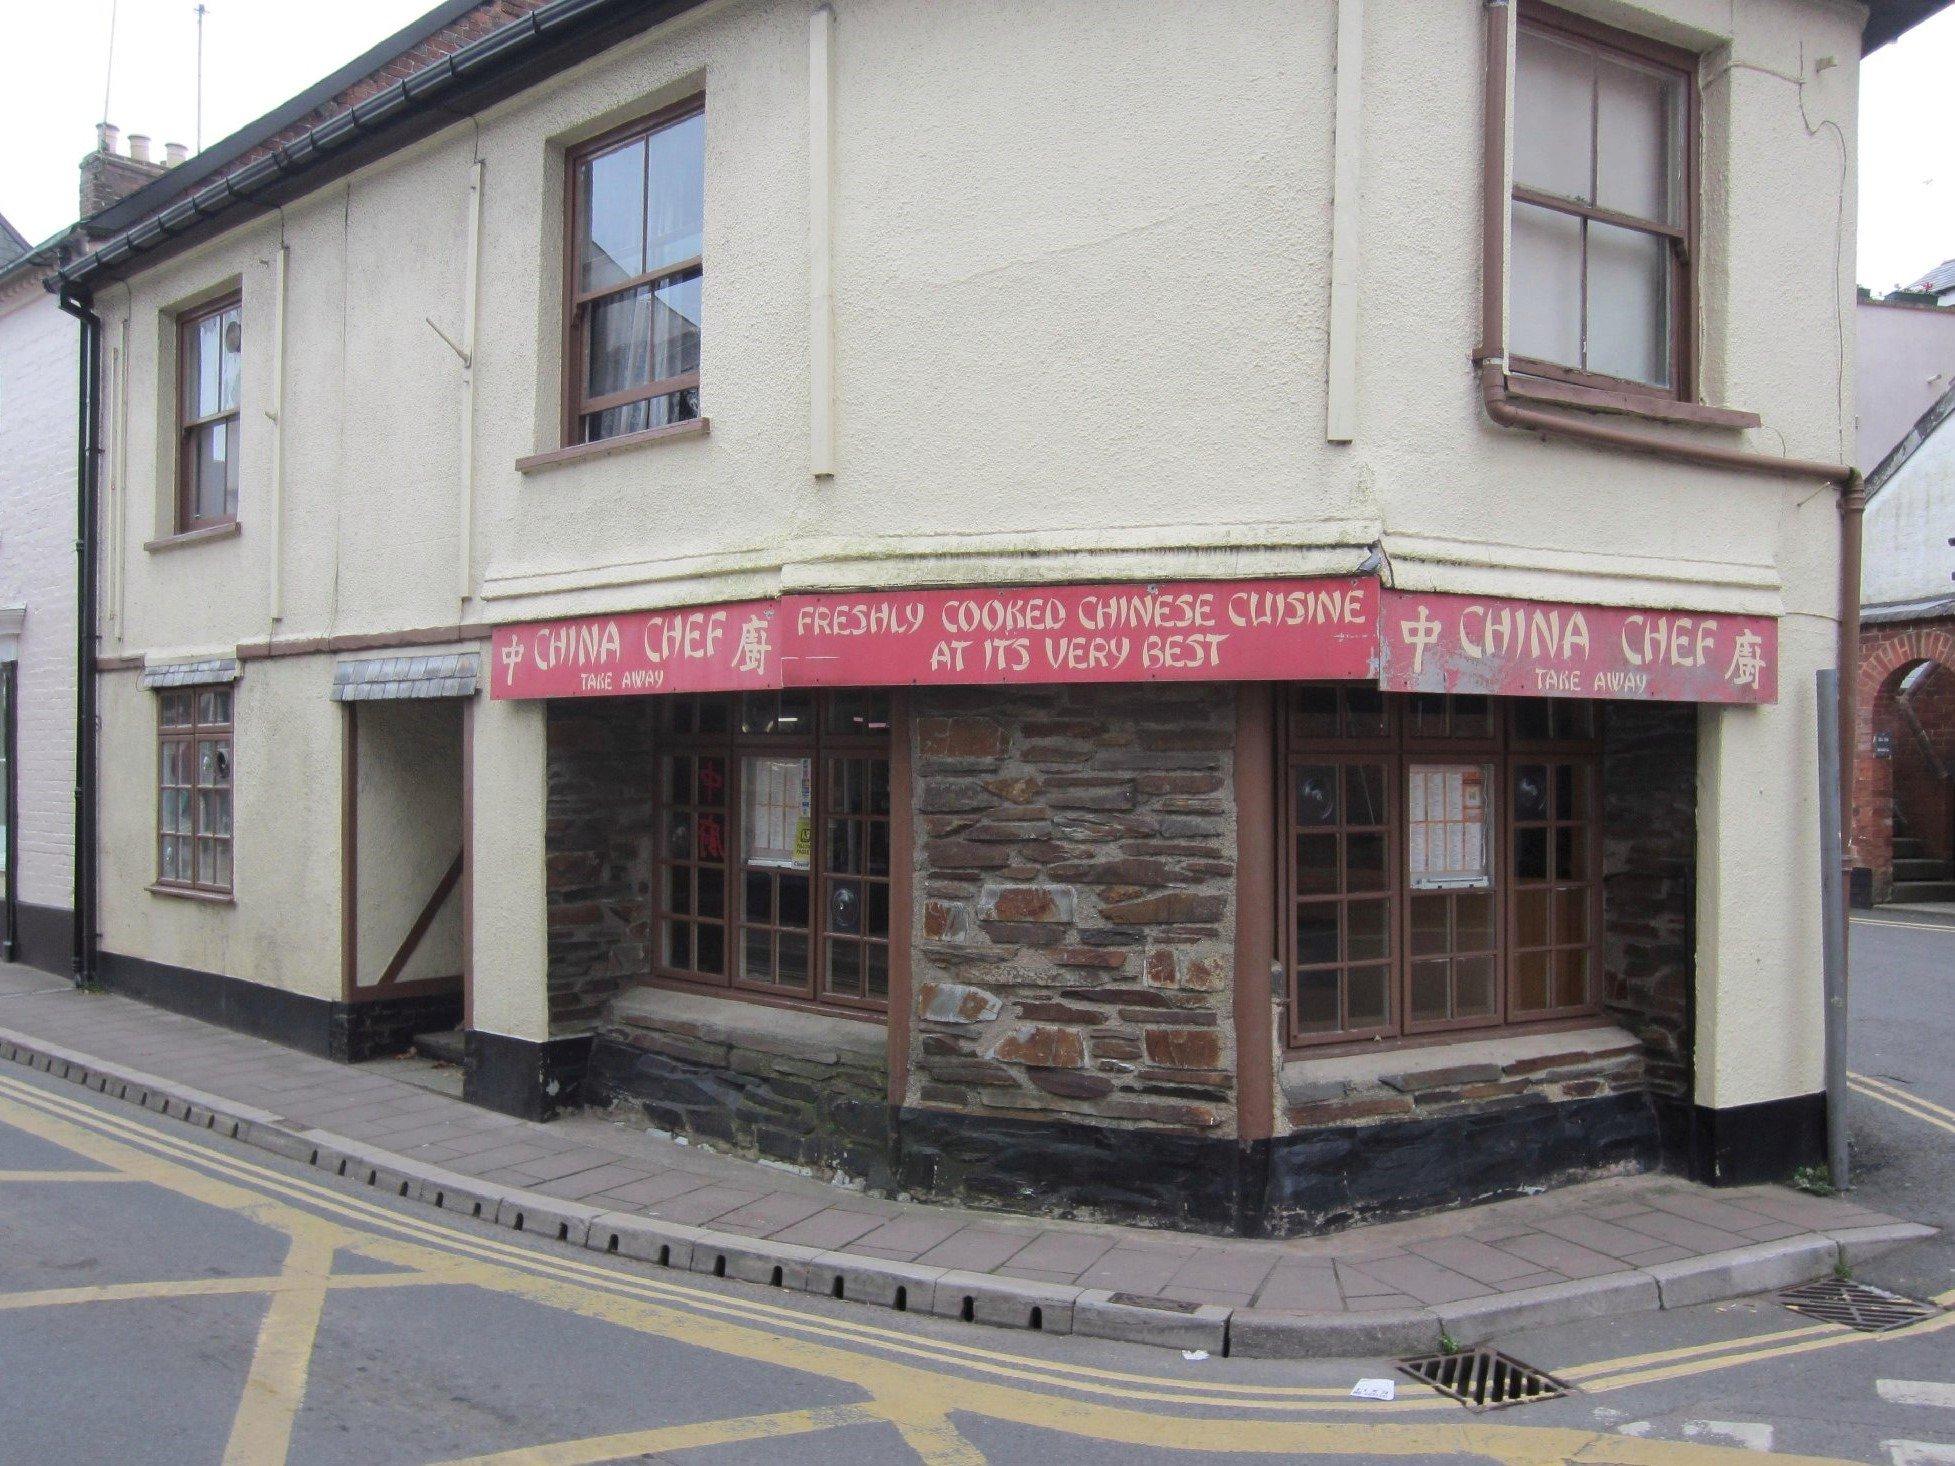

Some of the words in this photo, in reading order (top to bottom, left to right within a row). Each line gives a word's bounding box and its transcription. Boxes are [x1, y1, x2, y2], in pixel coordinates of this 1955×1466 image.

[797, 602, 924, 635] FRESHLY
[942, 598, 1066, 633] COOKED
[1079, 594, 1215, 630] CHINESE
[1229, 590, 1366, 628] CUISINE
[1459, 605, 1590, 661] CHINA
[1622, 615, 1718, 667] CHEF
[502, 634, 525, 686] 中
[534, 621, 620, 670] CHINA
[645, 611, 727, 662] CHEF
[930, 640, 973, 672] AT
[985, 638, 1030, 671] ITS
[1045, 636, 1130, 670] VERY
[1142, 633, 1230, 668] BEST
[1401, 606, 1442, 674] 中
[580, 672, 612, 690] TAKE
[622, 670, 664, 688] AWAY
[1535, 667, 1581, 691] TAKE
[1594, 670, 1649, 695] AWAY
